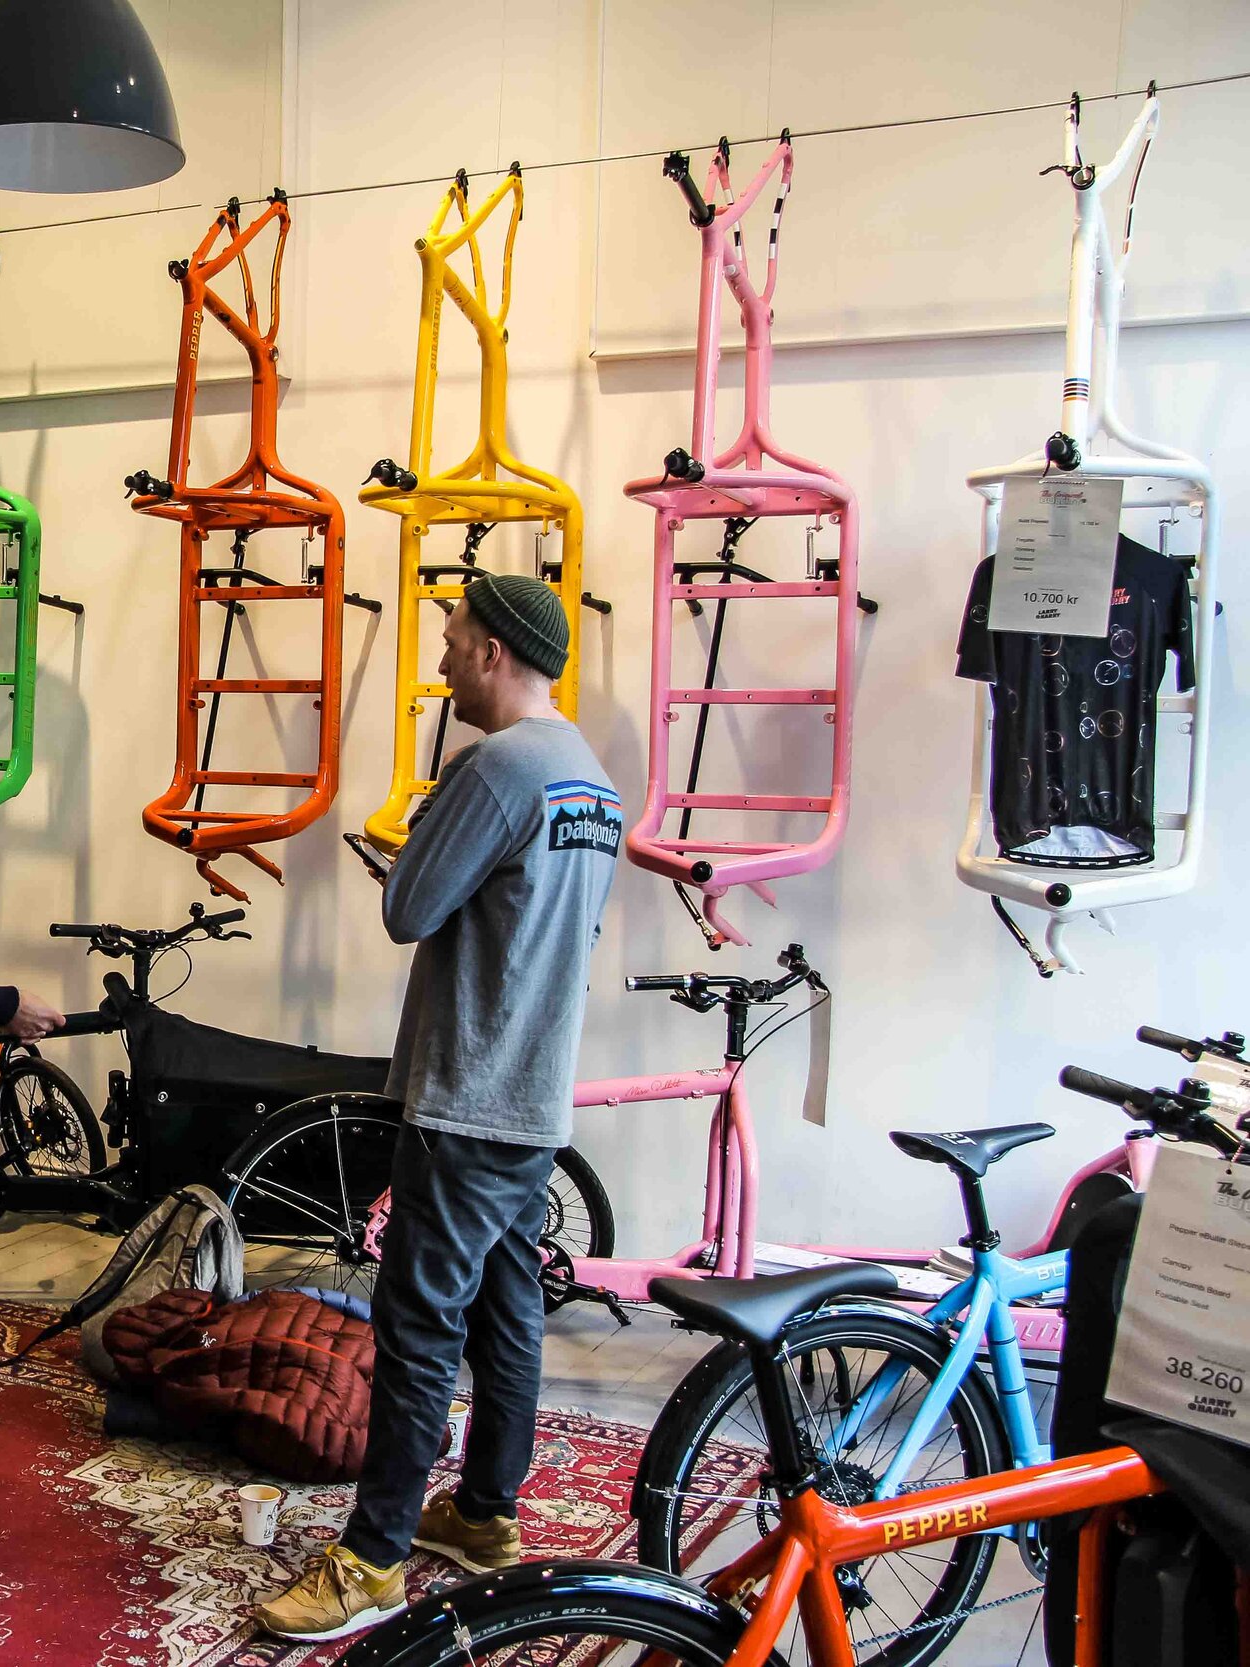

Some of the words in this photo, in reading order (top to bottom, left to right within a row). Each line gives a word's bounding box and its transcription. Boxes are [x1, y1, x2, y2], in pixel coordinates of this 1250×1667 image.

[190, 310, 202, 361] PEPPER
[430, 288, 442, 370] SUBMARINE
[1023, 592, 1063, 604] 10.700
[1067, 594, 1079, 604] kr
[556, 817, 619, 847] patagonia
[1217, 1181, 1240, 1196] The
[1161, 1257, 1192, 1271] Canopy
[1206, 1286, 1231, 1299] Board
[1165, 1356, 1243, 1394] 38.260
[1194, 1395, 1232, 1408] LARRY
[691, 1395, 725, 1445] MARATHON
[883, 1500, 989, 1545] PEPPER
